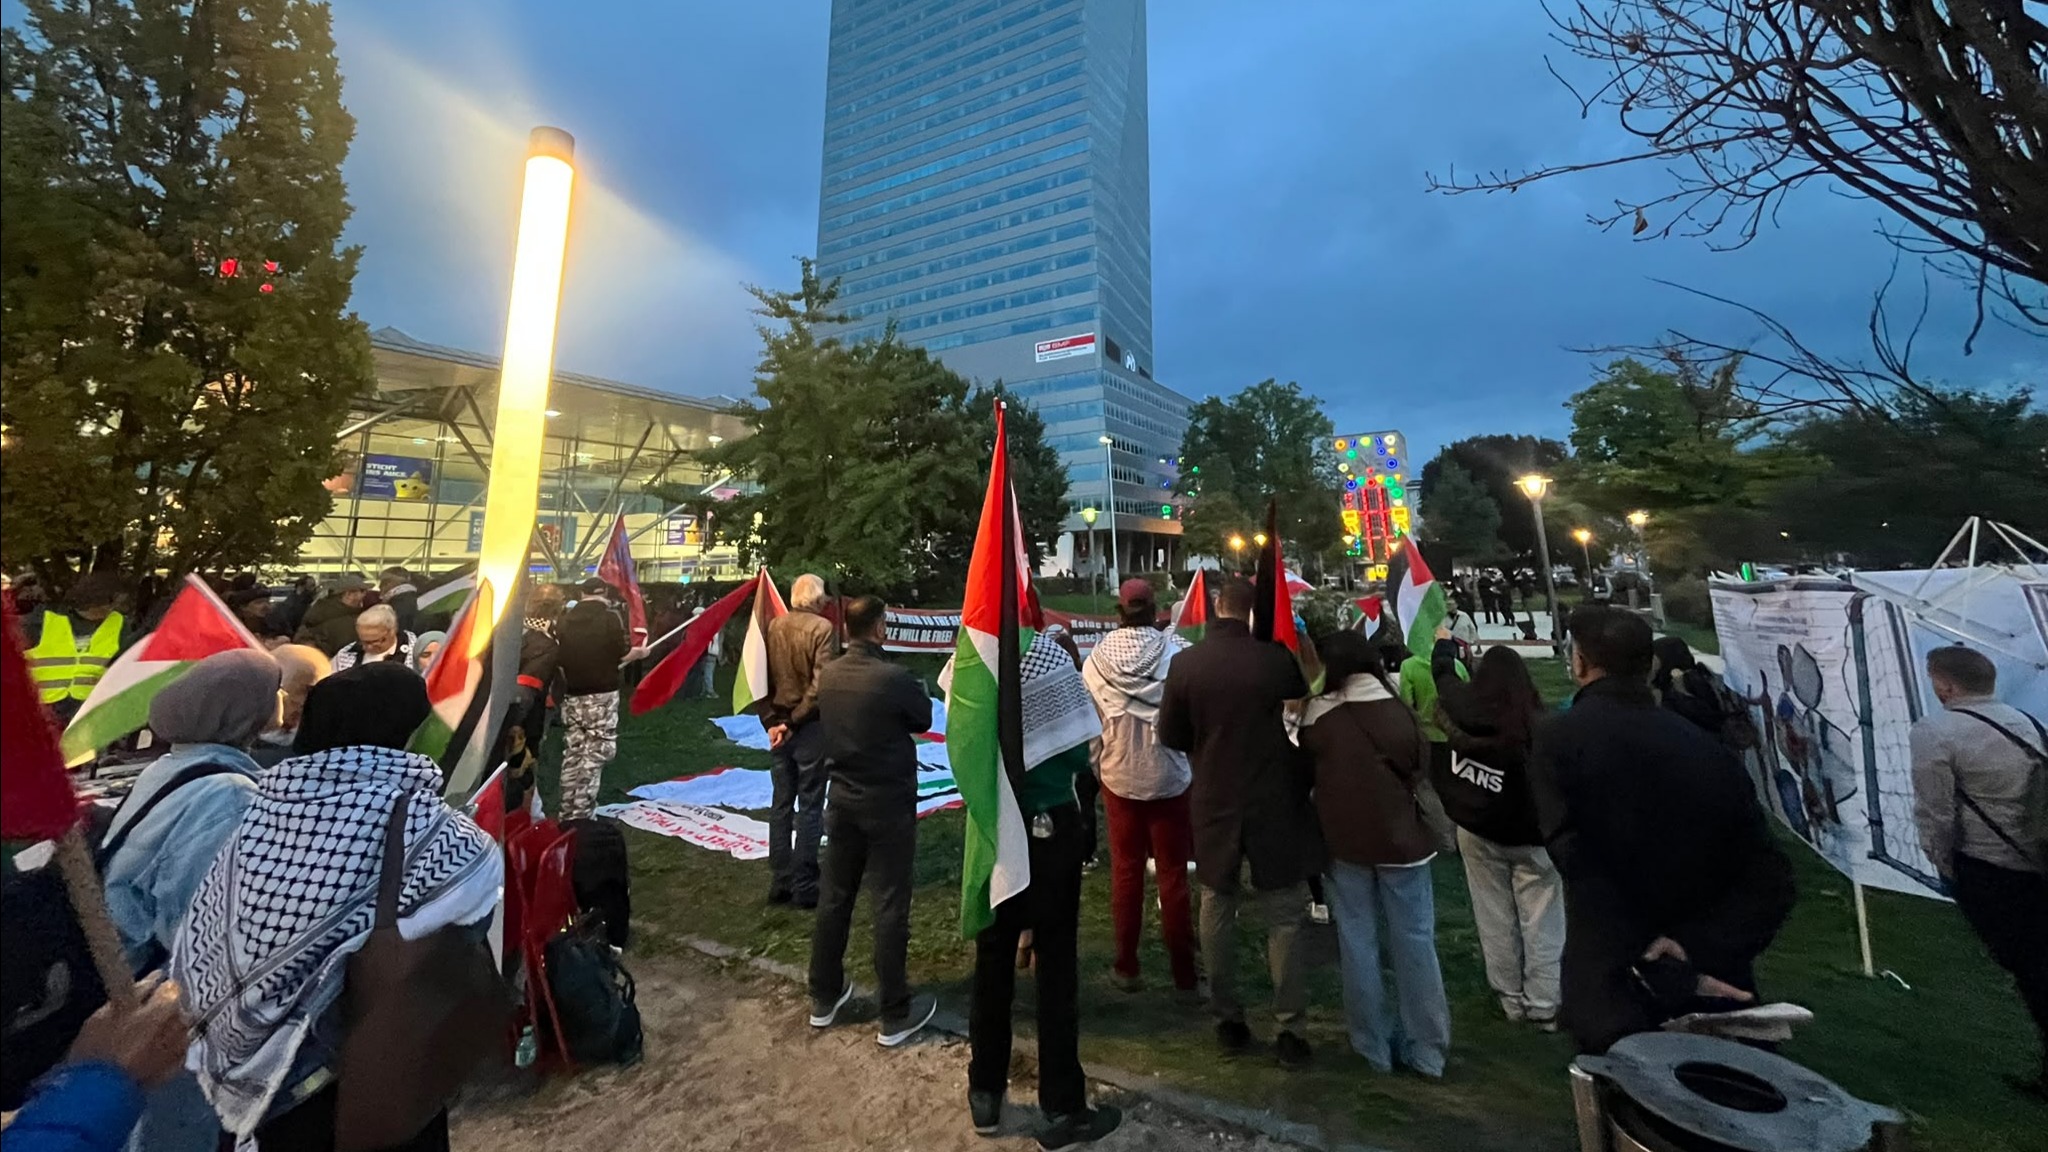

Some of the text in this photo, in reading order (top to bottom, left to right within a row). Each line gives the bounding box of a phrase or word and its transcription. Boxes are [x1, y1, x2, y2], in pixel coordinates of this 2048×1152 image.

[920, 615, 936, 626] TO
[932, 616, 950, 626] THE
[899, 629, 919, 641] WILL
[920, 629, 932, 642] BE
[1451, 749, 1505, 793] VANS
